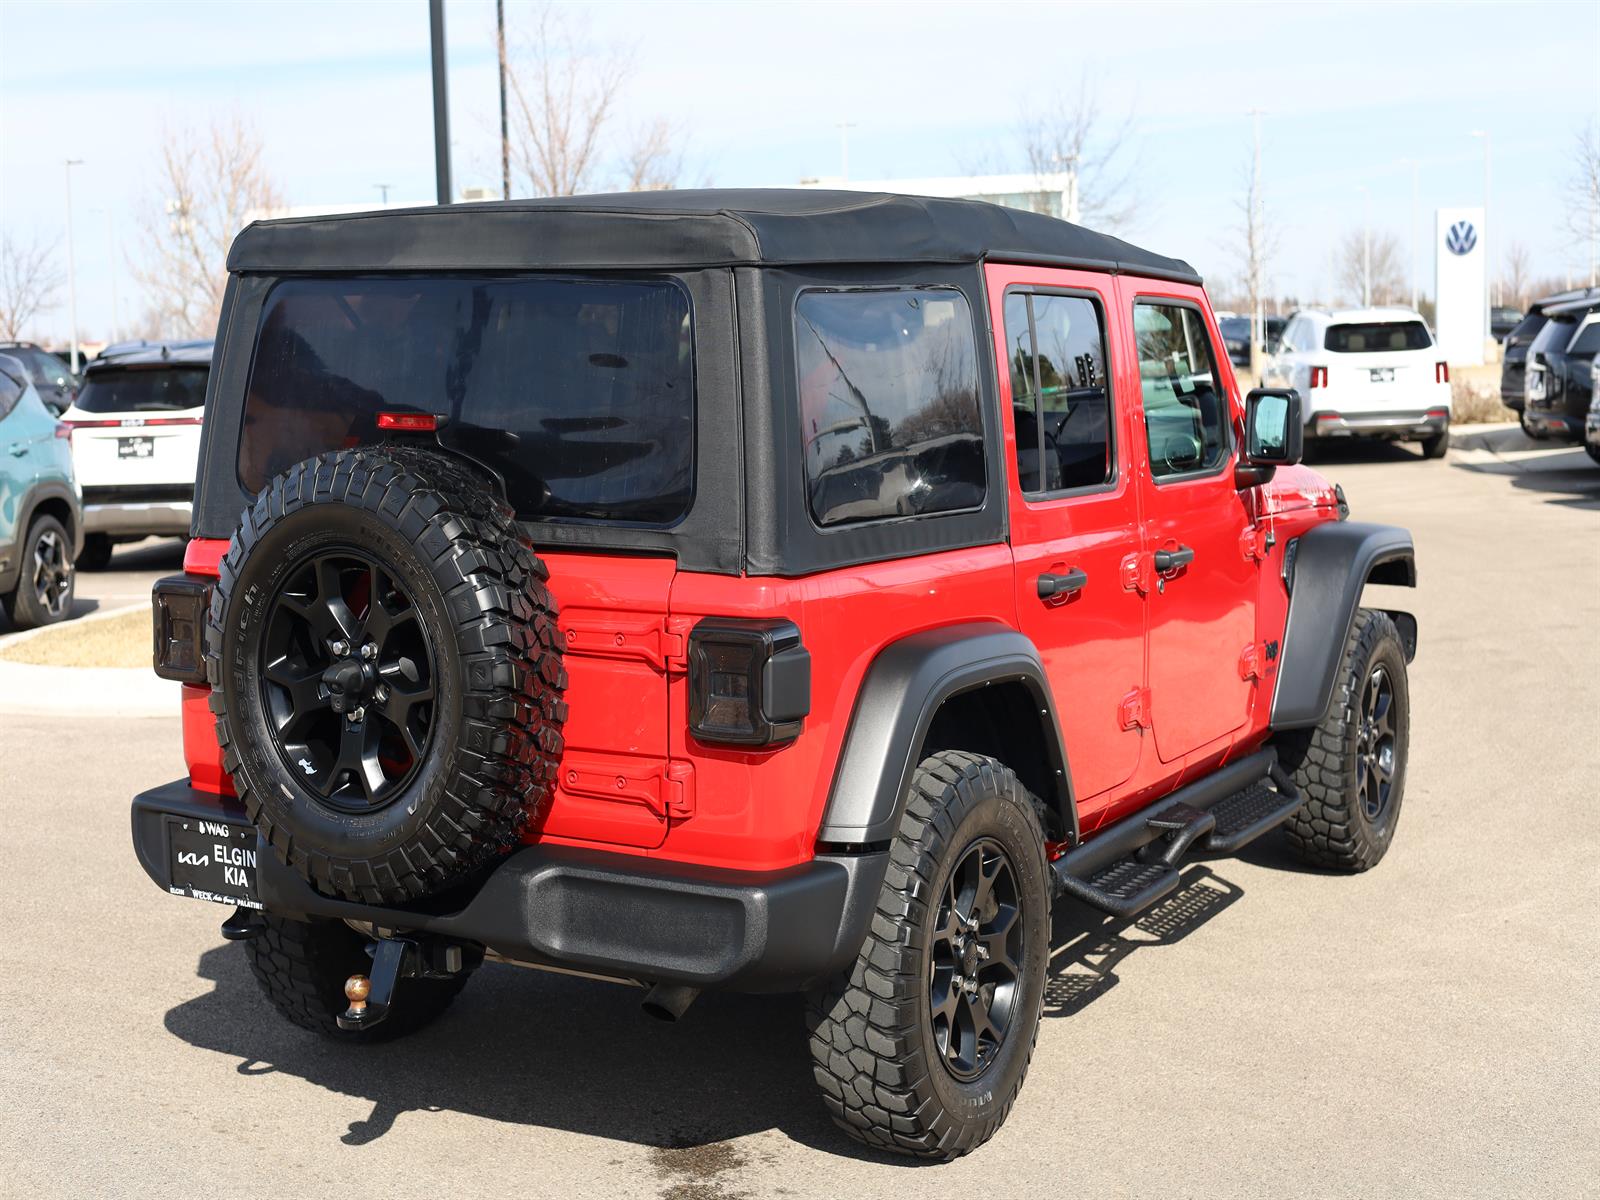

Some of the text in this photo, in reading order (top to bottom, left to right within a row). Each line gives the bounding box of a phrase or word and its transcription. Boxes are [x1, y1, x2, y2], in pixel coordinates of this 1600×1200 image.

[205, 821, 230, 838] WAG
[213, 844, 257, 868] ELGIN
[224, 866, 249, 888] KIA
[192, 889, 213, 901] WECK
[237, 899, 264, 910] PALATINE
